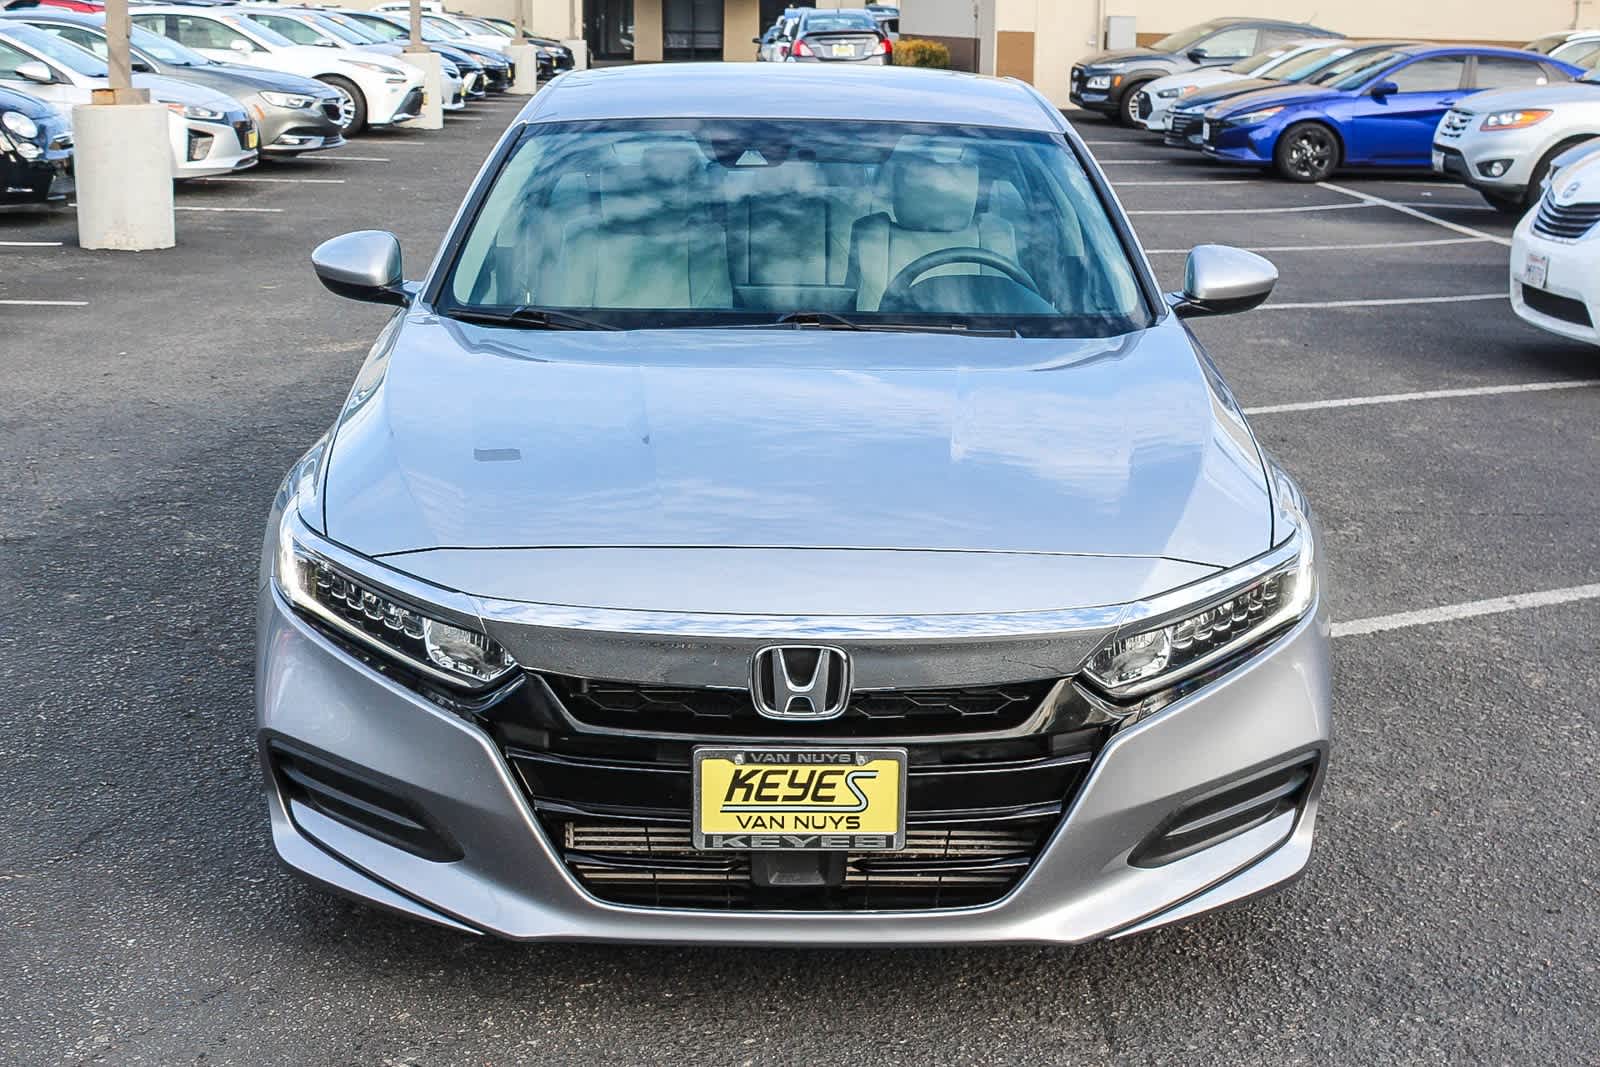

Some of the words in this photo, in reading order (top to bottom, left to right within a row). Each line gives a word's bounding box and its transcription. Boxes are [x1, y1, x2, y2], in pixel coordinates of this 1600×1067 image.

[750, 753, 790, 763] VAN
[797, 753, 851, 763] NUYS
[720, 769, 879, 813] KEYES
[736, 815, 785, 829] VAN
[794, 815, 861, 829] NUYS
[712, 835, 887, 848] KEYES
